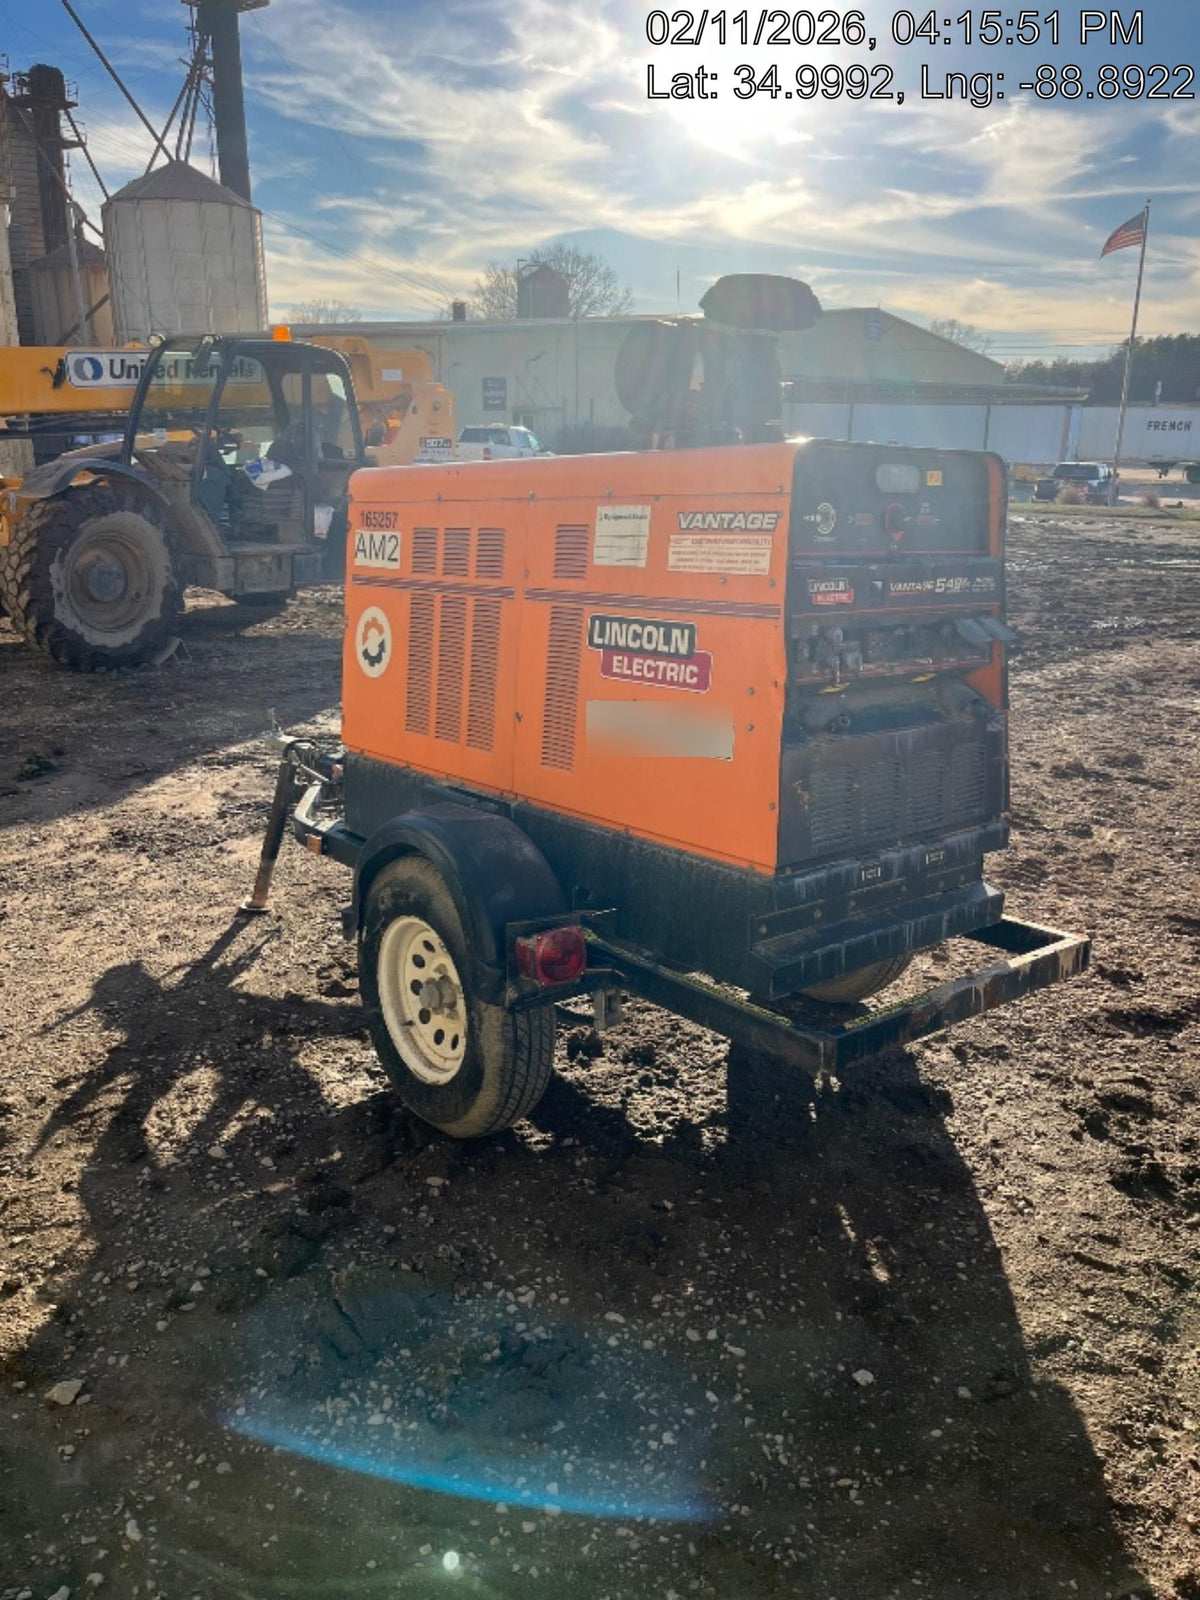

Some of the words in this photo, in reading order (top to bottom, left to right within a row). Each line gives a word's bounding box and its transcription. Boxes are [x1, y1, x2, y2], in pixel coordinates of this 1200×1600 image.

[109, 358, 178, 379] Unied
[1146, 420, 1192, 431] FRENCH
[360, 511, 399, 529] 165257
[677, 511, 780, 532] VANTAGE
[355, 533, 399, 562] AM2
[593, 620, 690, 655] LINCOLN
[612, 655, 699, 684] ELECTRIC
